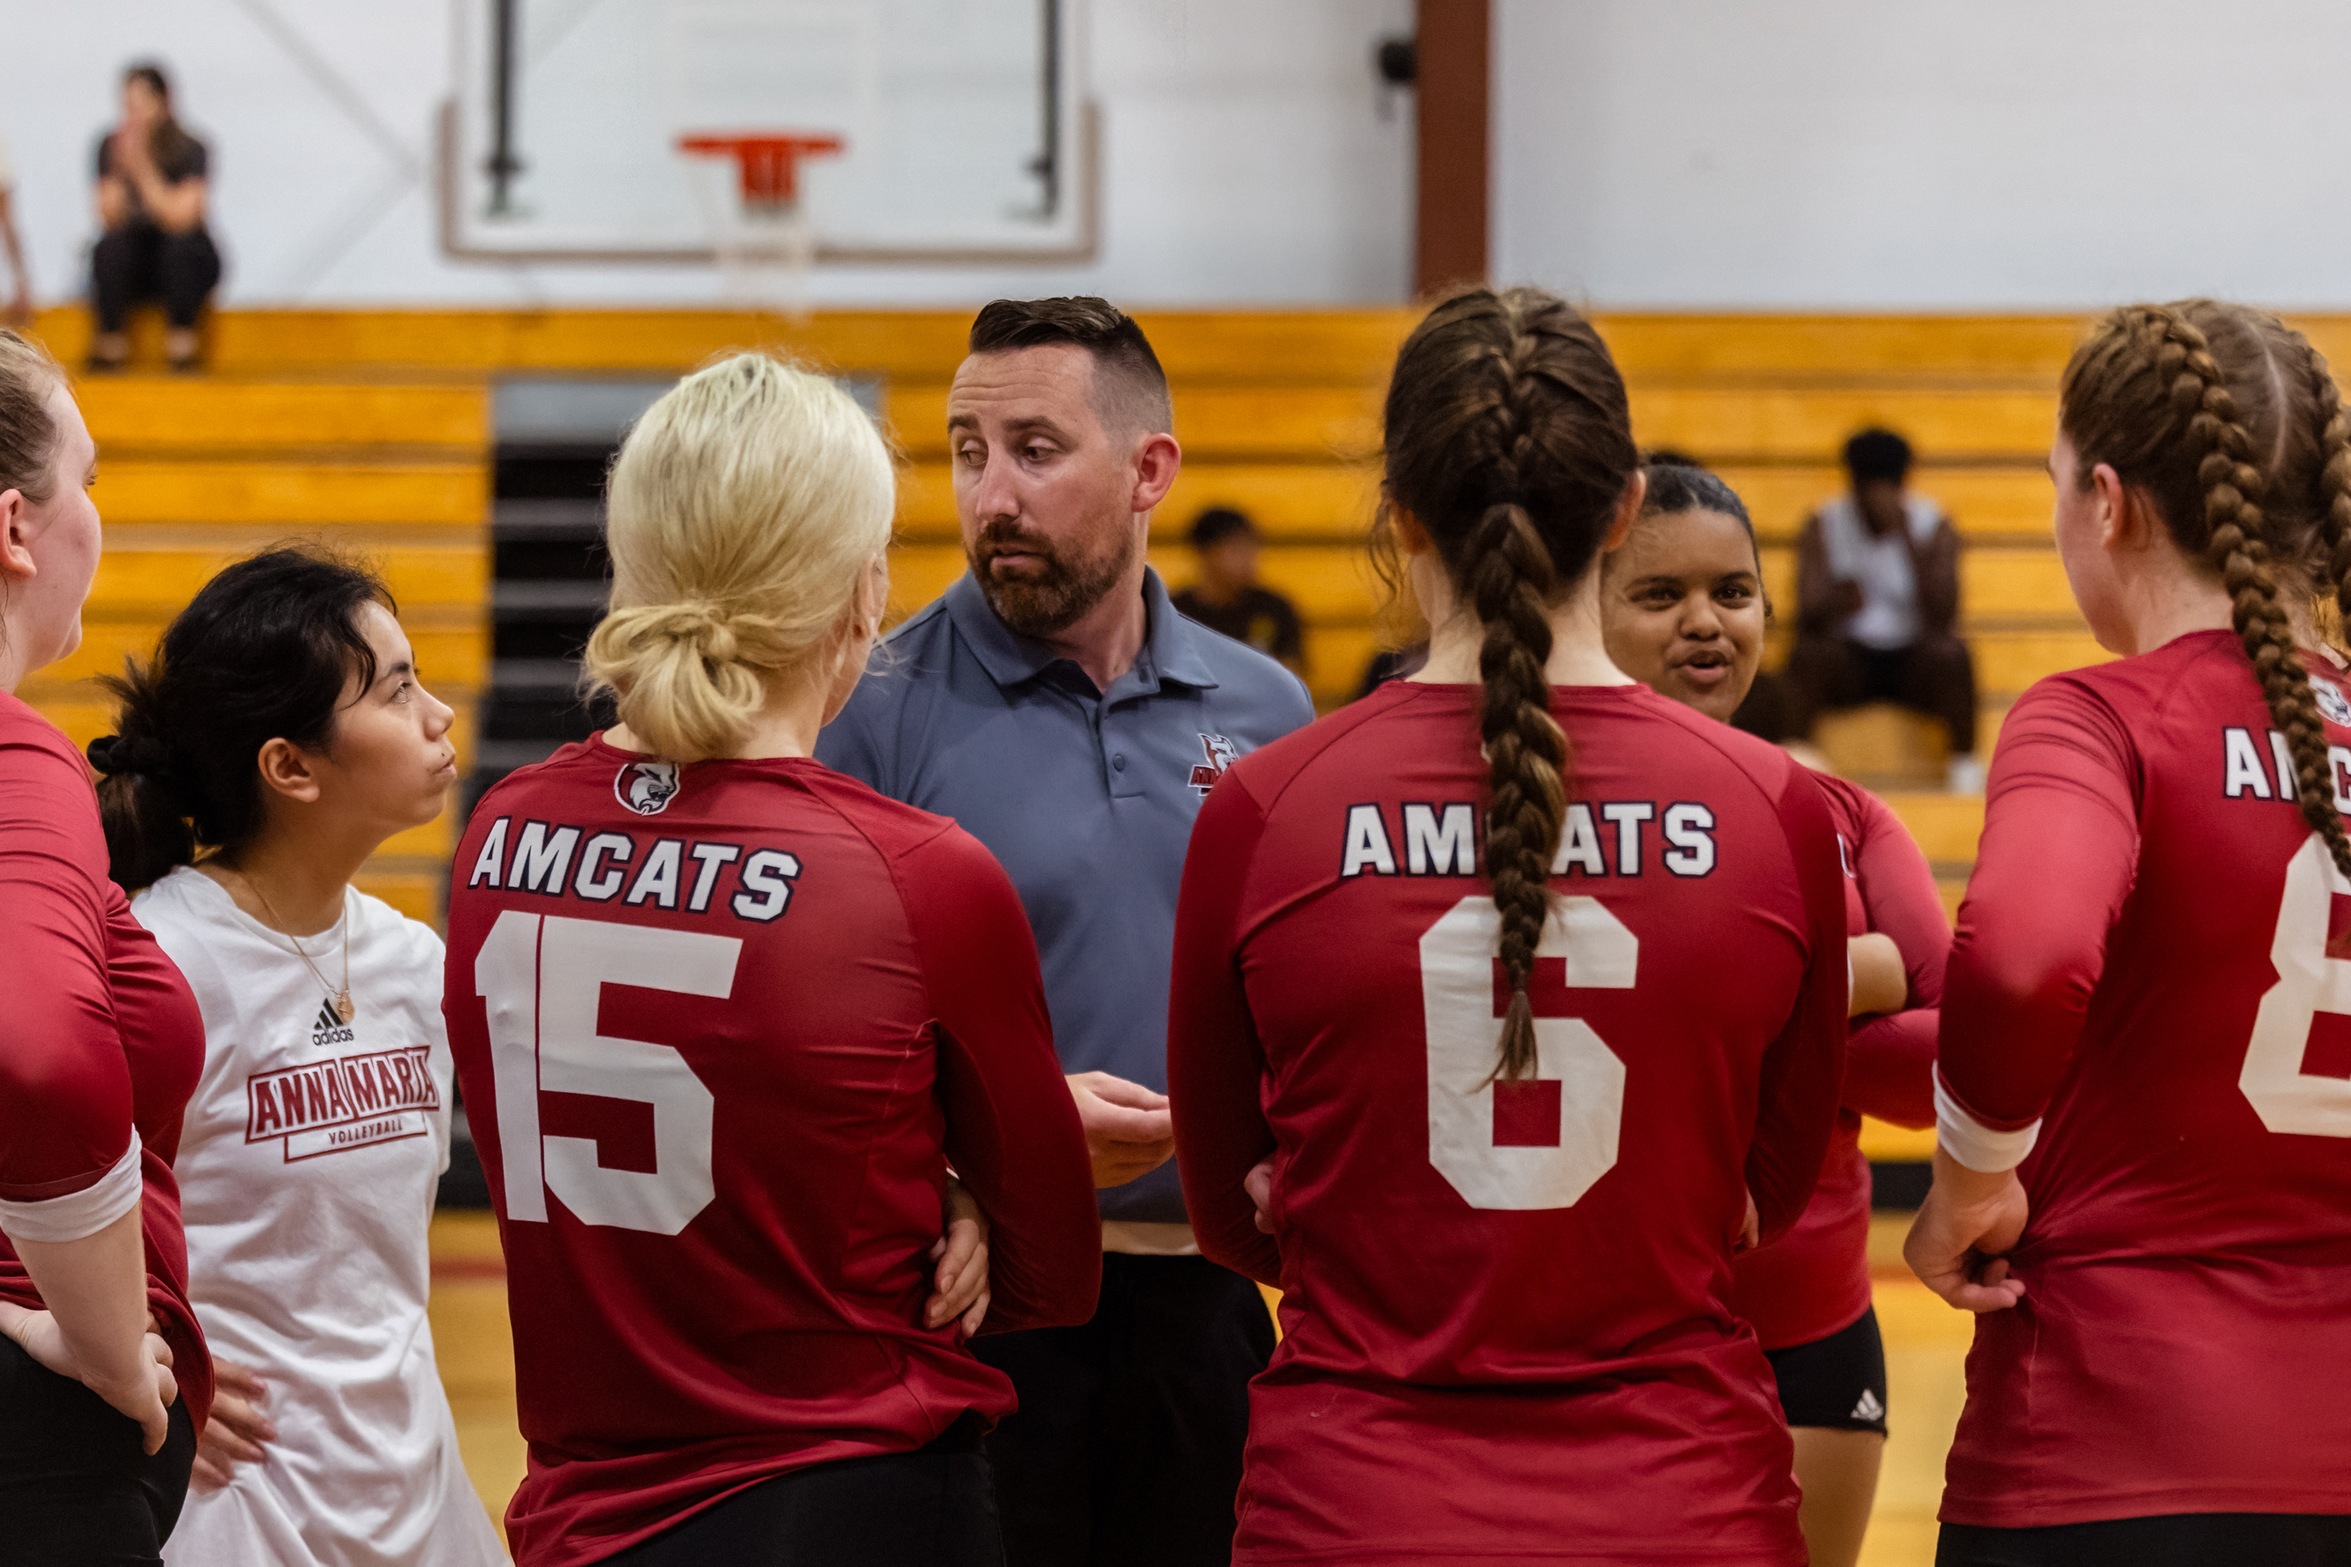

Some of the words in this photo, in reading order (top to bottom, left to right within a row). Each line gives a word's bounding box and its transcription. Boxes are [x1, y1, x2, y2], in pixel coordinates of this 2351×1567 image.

[468, 816, 803, 923] AMCATS
[1341, 801, 1718, 878] AMATS
[312, 1028, 354, 1046] adidas
[474, 910, 744, 1236] 15
[1419, 895, 1639, 1210] 6
[254, 1065, 350, 1134] ANNA
[349, 1055, 436, 1113] MARIA
[328, 1118, 402, 1145] VOLLEYBALL
